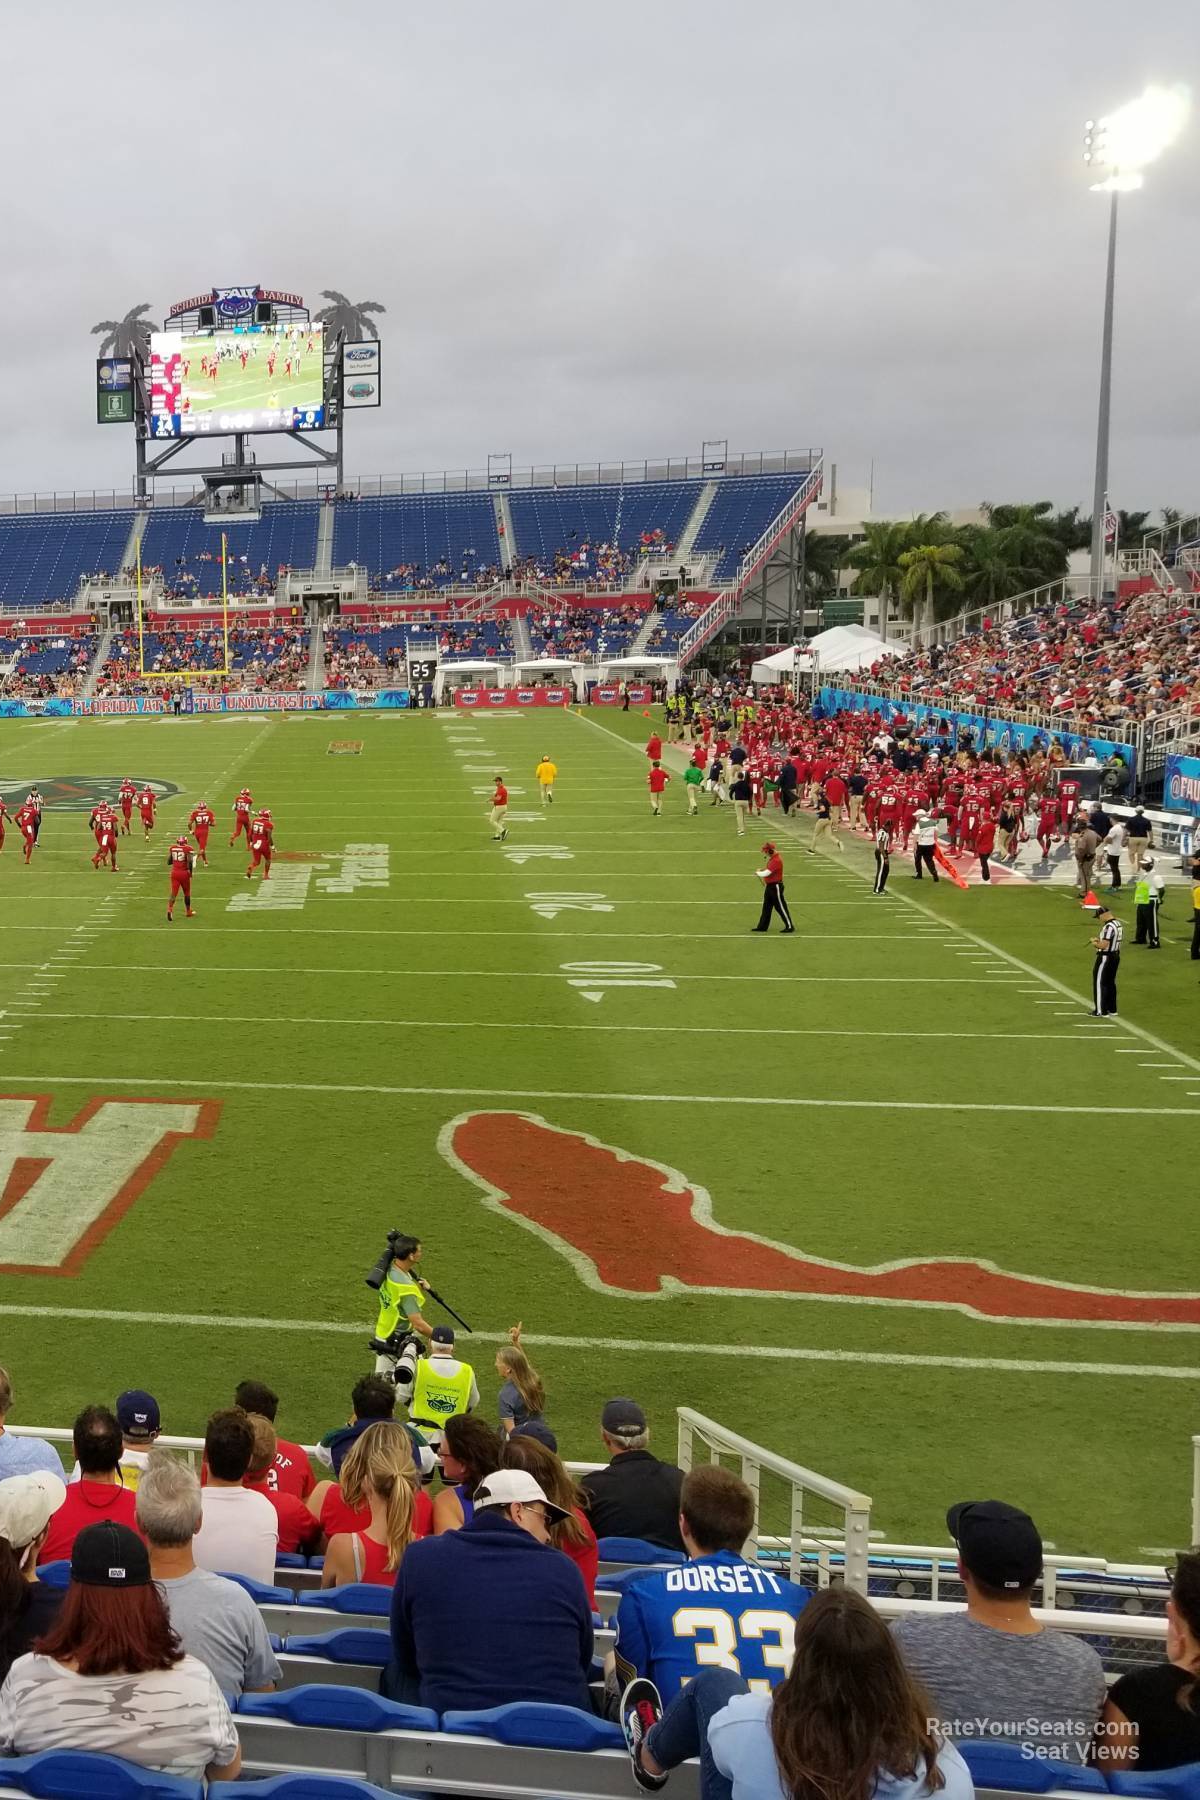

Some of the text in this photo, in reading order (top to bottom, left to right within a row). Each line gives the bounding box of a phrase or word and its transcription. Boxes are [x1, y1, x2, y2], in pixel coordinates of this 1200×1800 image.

[171, 289, 302, 315] SCHMIDT FAMILY
[351, 350, 371, 359] Ford
[413, 664, 429, 677] 25
[72, 697, 138, 714] FLORIDA
[226, 694, 326, 711] UNIVERSITY
[881, 796, 896, 805] 52
[23, 812, 30, 821] 7
[196, 815, 209, 825] 97
[523, 892, 616, 911] 20
[559, 961, 677, 989] 10
[666, 1565, 782, 1595] DORSETT
[672, 1607, 797, 1697] 33
